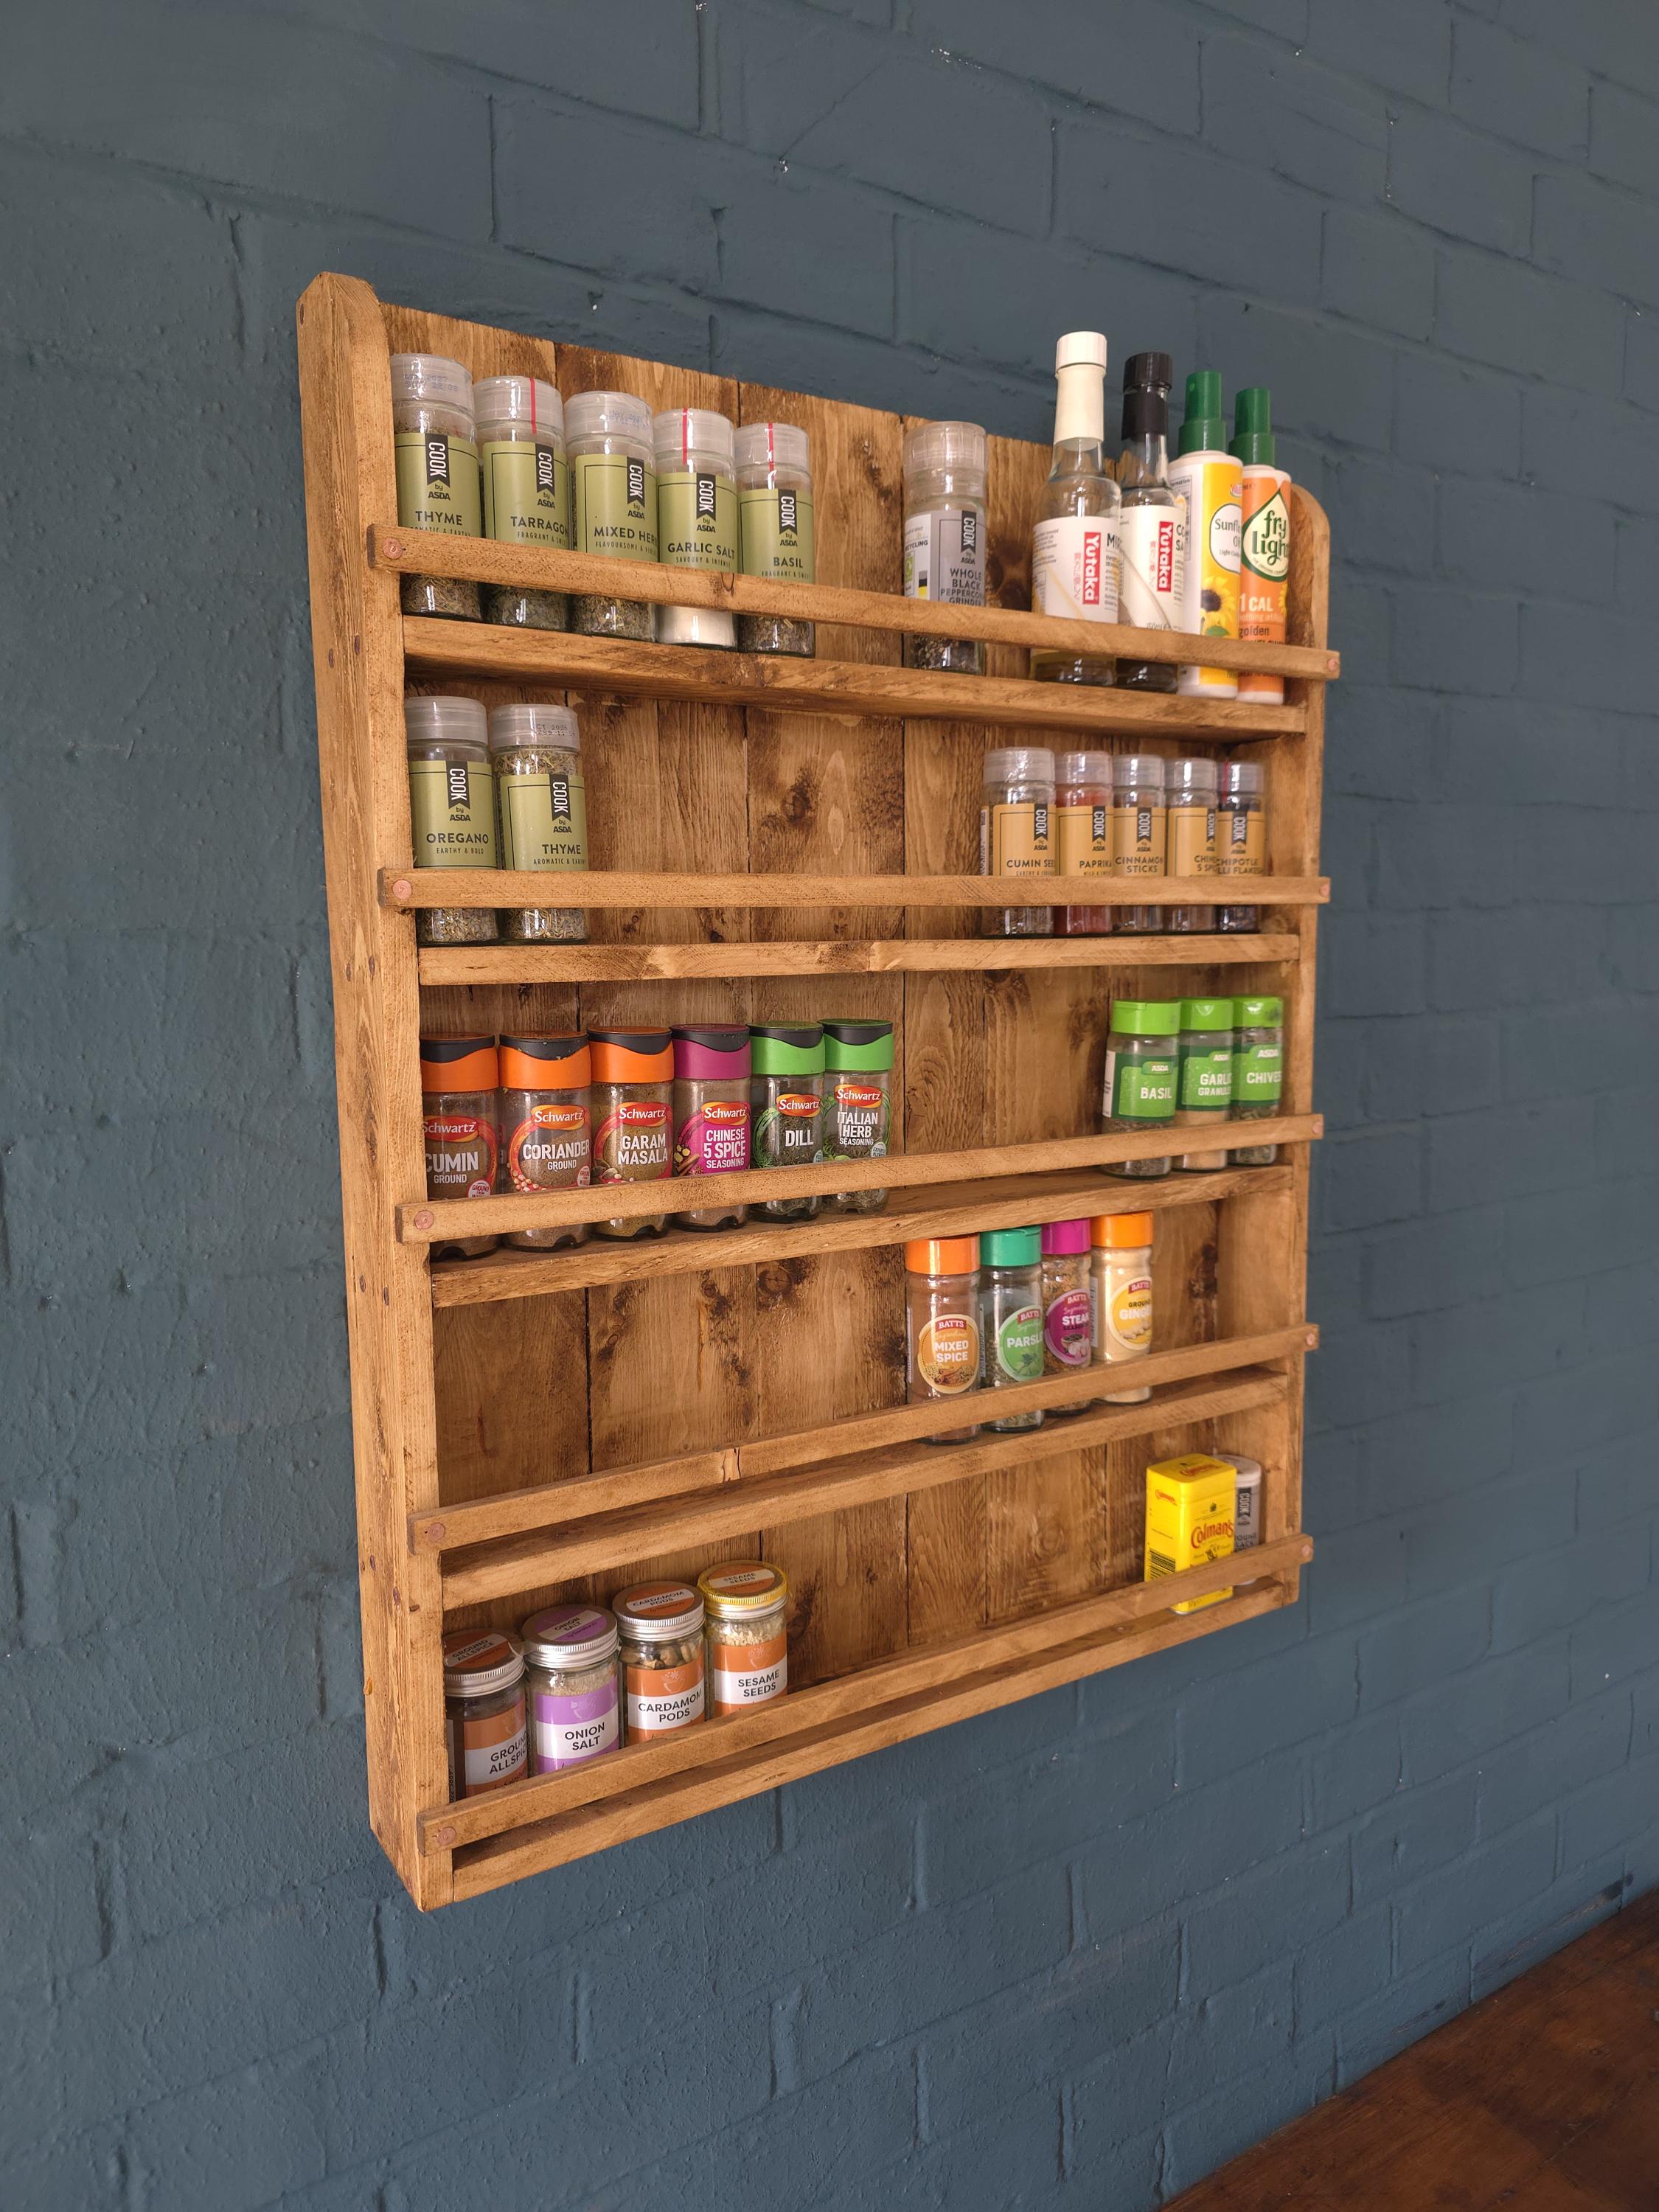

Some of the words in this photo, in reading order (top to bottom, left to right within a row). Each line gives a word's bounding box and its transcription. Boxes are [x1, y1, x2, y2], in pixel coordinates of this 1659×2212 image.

[428, 442, 447, 478] COOK
[538, 451, 553, 487] COOK
[629, 465, 643, 499] COOK
[428, 491, 451, 501] ASDA
[699, 480, 714, 512] COOK
[537, 498, 555, 509] ASDA
[415, 510, 463, 526] THYME
[627, 510, 645, 520] ASDA
[781, 495, 795, 528] COOK
[697, 524, 716, 533] ASDA
[1261, 509, 1287, 540] fry
[517, 531, 549, 541] FRAGRANT
[594, 526, 635, 539] MIXED
[963, 517, 975, 548] COOK
[595, 540, 638, 551] FLAVOURSOME
[779, 539, 798, 547] ASDA
[667, 542, 712, 554] GARLIC
[716, 546, 735, 560] SALT
[1158, 524, 1173, 589] Yutaka
[712, 559, 731, 568] INTENSE
[773, 557, 803, 568] BASIL
[961, 557, 976, 566] ASDA
[1084, 533, 1100, 601] Yutaka
[950, 567, 982, 582] WHOLE
[952, 578, 981, 591] BLACK
[940, 588, 983, 599] PEPPERCO
[1239, 593, 1247, 612] 1
[1248, 596, 1274, 613] CAL
[449, 768, 467, 801] COOK
[552, 782, 568, 813] COOK
[1035, 809, 1047, 835] COOK
[1093, 810, 1105, 836] COOK
[1138, 813, 1151, 838] COOK
[1233, 816, 1247, 841] COOK
[426, 832, 489, 844] OREGANO
[541, 844, 581, 855] THYME
[1006, 859, 1041, 868] CUMIN
[1114, 856, 1164, 865] CINNAMON
[1215, 858, 1258, 866] CHIPOTLE
[1126, 865, 1158, 873] STICKS
[1257, 1048, 1279, 1058] ASDA
[836, 1088, 882, 1101] Schwartz
[1140, 1087, 1172, 1099] BASIL
[779, 1099, 820, 1110] Schwartz
[534, 1110, 584, 1123] Schwartz
[619, 1107, 667, 1119] Schwartz
[703, 1107, 747, 1119] Schwartz
[837, 1111, 879, 1125] ITALIAN
[422, 1121, 476, 1133] Schwartz
[841, 1125, 872, 1138] HERB
[622, 1133, 666, 1150] GARAM
[706, 1127, 745, 1142] CHINESE
[785, 1129, 814, 1147] DILL
[523, 1138, 591, 1161] CORIANDER
[703, 1142, 712, 1159] 5
[714, 1140, 746, 1159] SPICE
[839, 1138, 874, 1147] SEASONING
[425, 1151, 479, 1173] CUMIN
[617, 1147, 668, 1165] MASALA
[706, 1157, 745, 1169] SEASONING
[547, 1159, 577, 1171] GROUND
[434, 1173, 467, 1184] GROUND
[938, 1320, 964, 1329] BATTS
[934, 1340, 969, 1352] MIXED
[936, 1352, 968, 1363] SPICE
[1239, 1492, 1251, 1513] COOK
[1190, 1520, 1234, 1549] Colman's
[723, 1572, 756, 1582] SESAME
[633, 1591, 684, 1606] CARDAMOM
[554, 1617, 581, 1631] ONION
[564, 1621, 582, 1631] SALT
[452, 1639, 489, 1658] GROUND
[457, 1641, 495, 1661] ALLSPICE
[737, 1669, 780, 1688] SESAME
[743, 1682, 776, 1697] SEEDS
[638, 1689, 703, 1713] CARDAMOM
[658, 1708, 691, 1723] PODS
[565, 1722, 605, 1740] ONION
[571, 1736, 601, 1750] SALT
[489, 1743, 528, 1775] ALLSPIC
